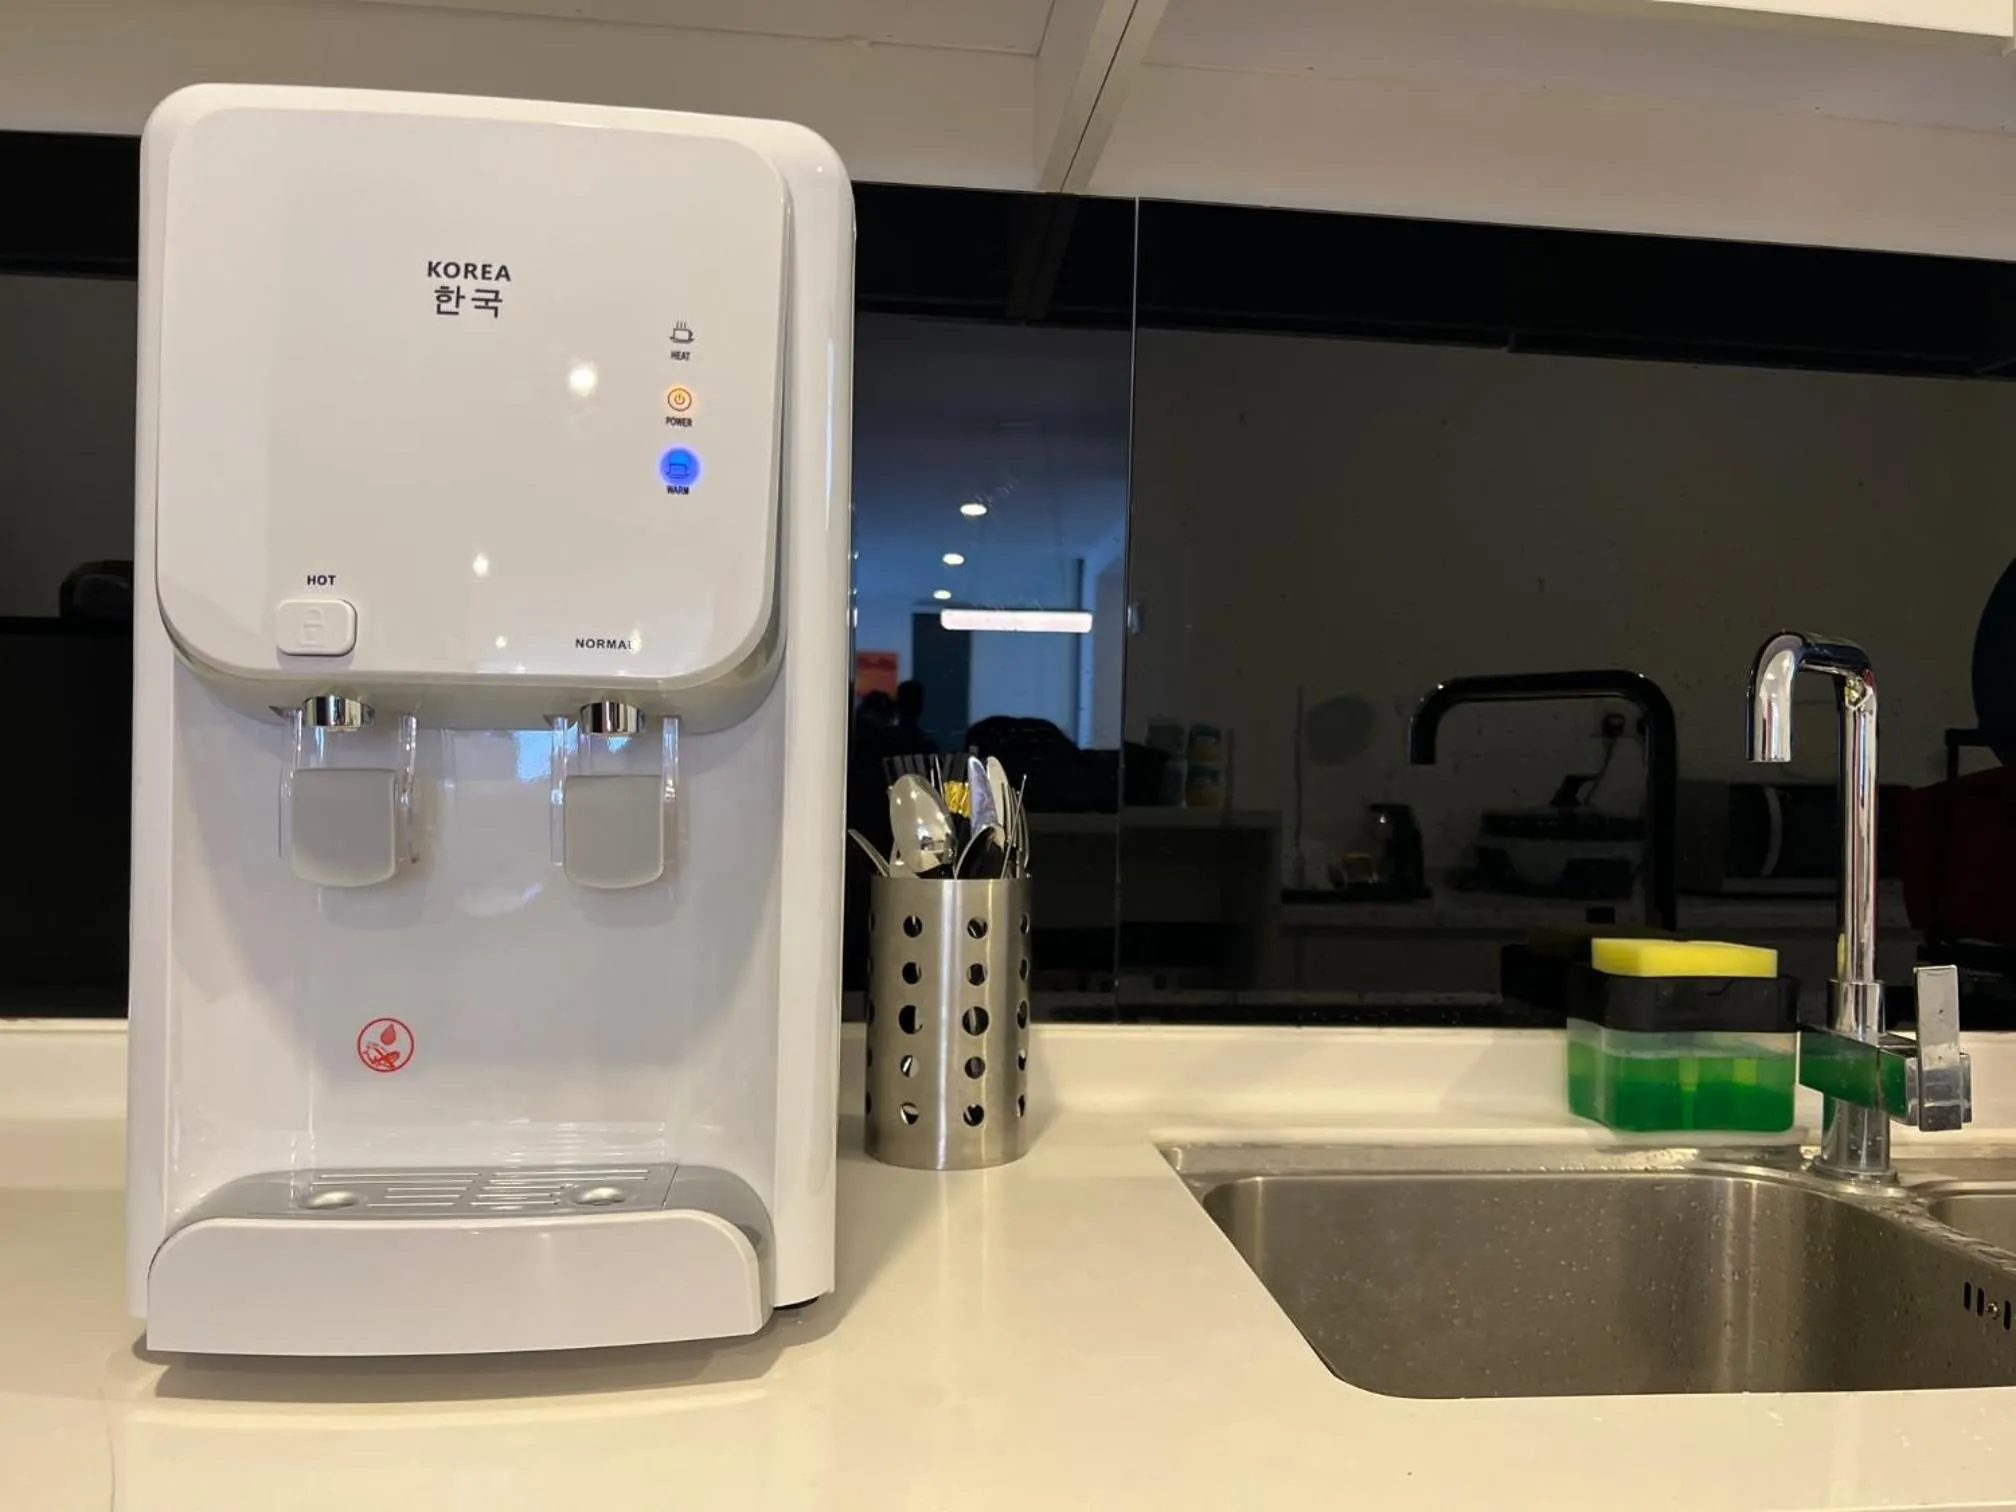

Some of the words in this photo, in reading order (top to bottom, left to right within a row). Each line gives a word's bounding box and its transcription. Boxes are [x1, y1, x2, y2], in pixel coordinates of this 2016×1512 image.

[427, 261, 511, 282] KOREA
[434, 285, 503, 318] 한국
[670, 350, 691, 361] HEAT
[666, 416, 692, 428] POWER
[666, 485, 689, 495] WARM
[307, 574, 336, 586] HOT
